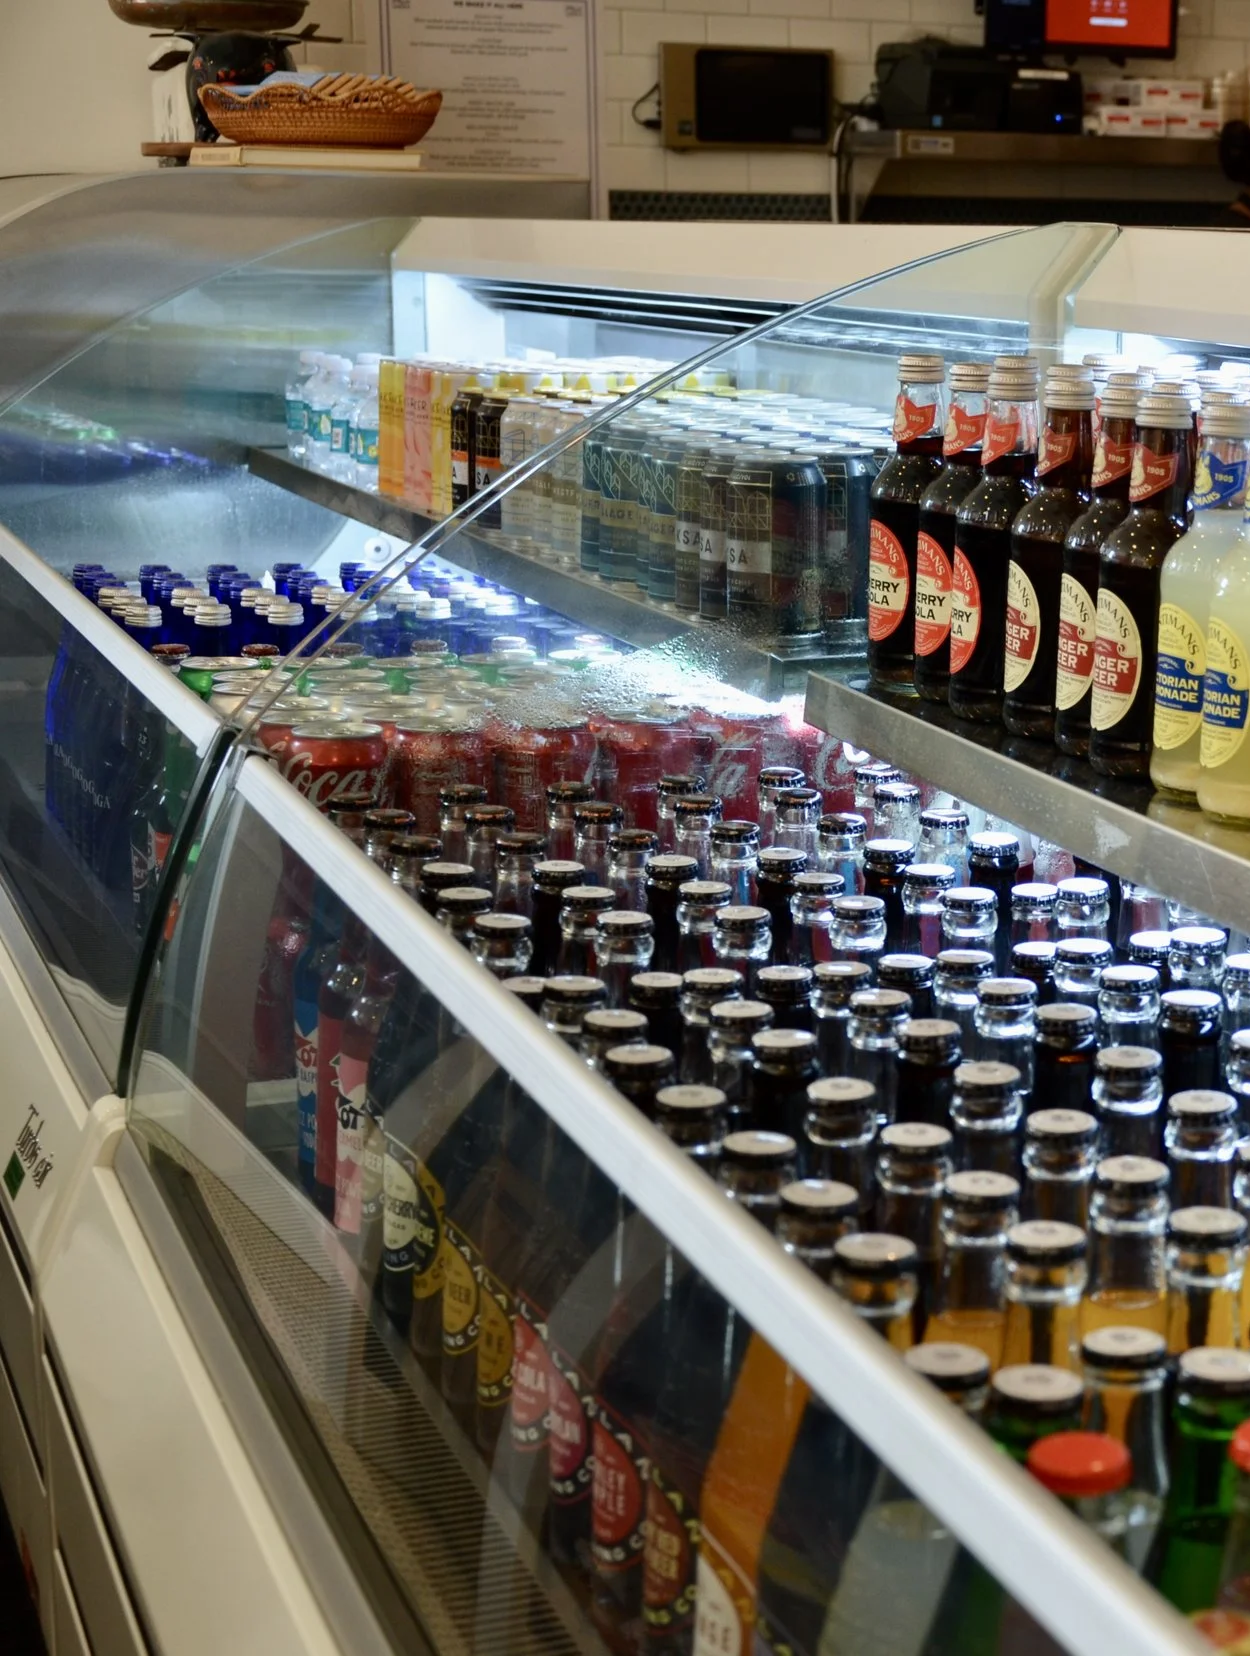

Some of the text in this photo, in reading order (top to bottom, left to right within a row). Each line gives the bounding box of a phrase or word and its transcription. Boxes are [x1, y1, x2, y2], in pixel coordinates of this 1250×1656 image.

[1108, 453, 1126, 464] 1905
[1146, 465, 1165, 476] 1905
[1214, 472, 1234, 483] 1905
[870, 578, 900, 594] ERRY
[870, 592, 890, 606] OLA
[917, 592, 946, 607] ERRY
[1203, 704, 1240, 719] ONADE
